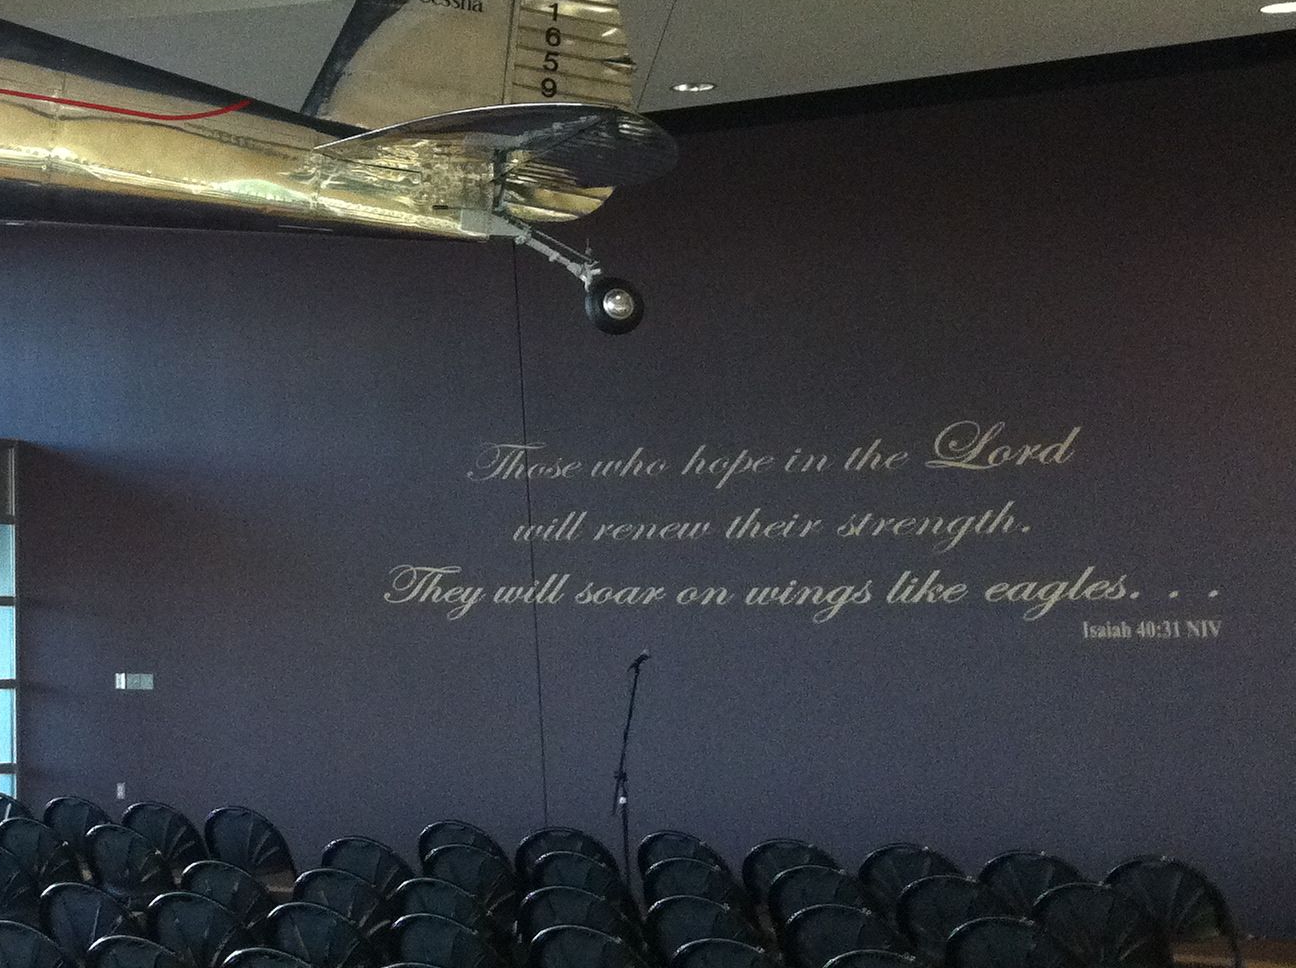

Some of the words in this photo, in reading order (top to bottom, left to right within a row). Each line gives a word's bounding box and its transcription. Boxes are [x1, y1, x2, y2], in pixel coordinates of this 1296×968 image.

[466, 441, 582, 481] Those
[591, 447, 668, 478] who
[680, 444, 774, 489] hope
[784, 448, 832, 472] in
[844, 438, 910, 472] the
[925, 420, 1081, 470] Lord
[512, 511, 588, 541] will
[593, 521, 711, 541] renew
[725, 507, 824, 539] their
[837, 500, 1031, 554] strength.
[383, 564, 484, 621] They
[492, 573, 571, 605] will
[575, 581, 666, 605] soar
[676, 583, 735, 605] on
[746, 580, 872, 624] wings
[886, 569, 969, 604] like
[1082, 620, 1133, 639] Isaiah
[1136, 620, 1181, 639] 40:31
[1186, 619, 1222, 639] NIV
